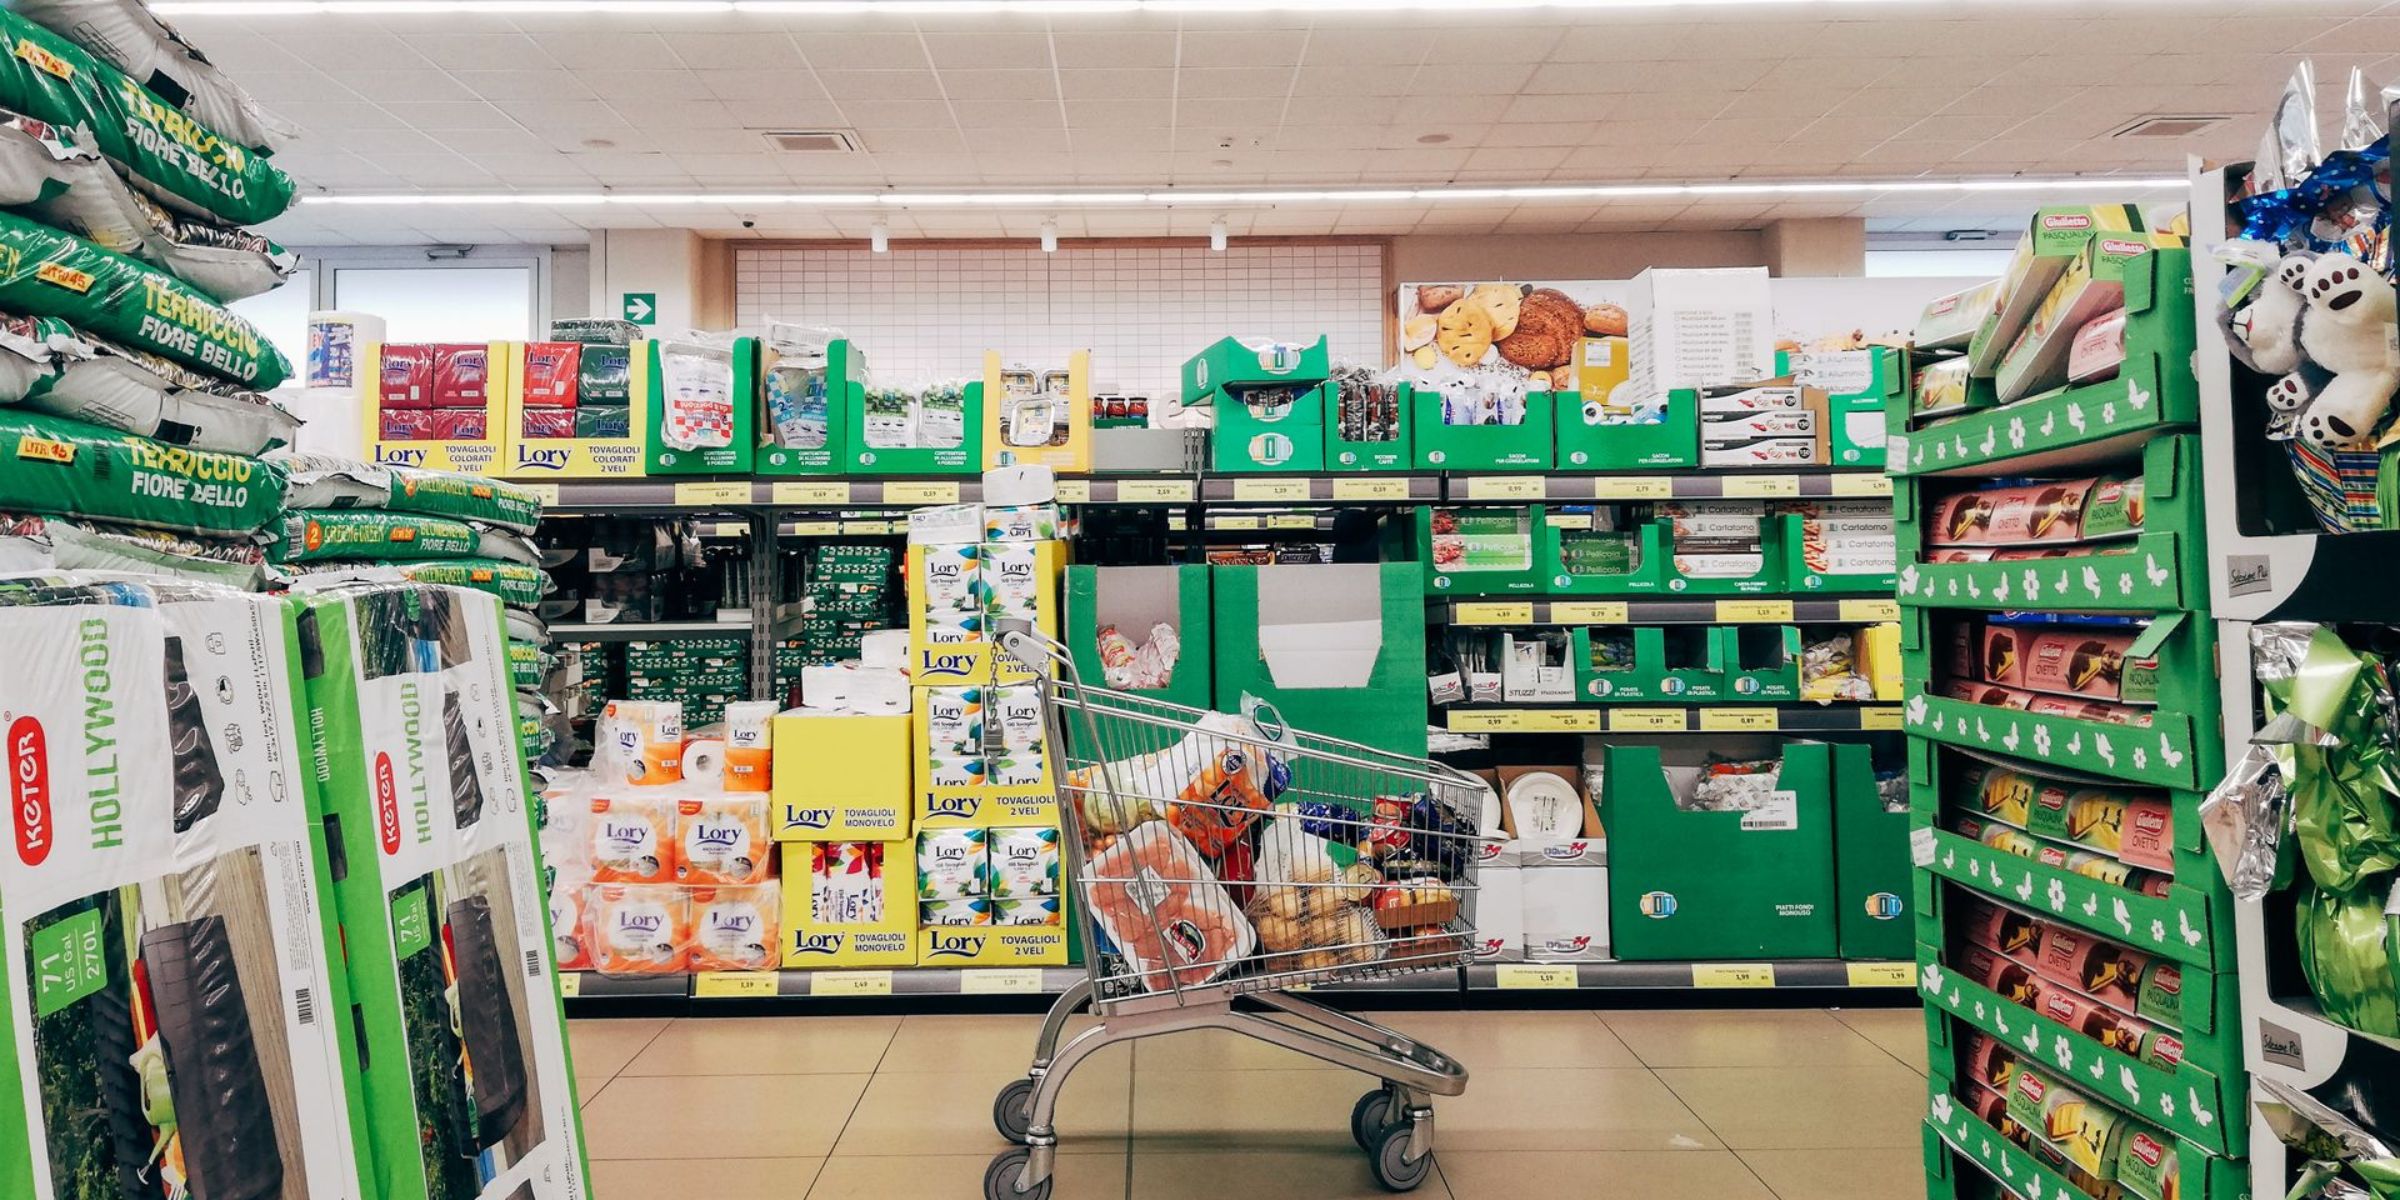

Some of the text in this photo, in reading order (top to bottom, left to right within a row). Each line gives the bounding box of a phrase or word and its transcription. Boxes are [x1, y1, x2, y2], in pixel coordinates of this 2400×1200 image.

[125, 116, 246, 200] FIORE BELLO
[2042, 231, 2094, 241] PASQUALIN
[67, 273, 87, 290] 45
[139, 316, 198, 356] FIORE
[200, 340, 258, 382] BELLO
[50, 443, 68, 460] 45
[375, 444, 428, 469] Lory
[445, 445, 497, 454] TOVAGLIOLI
[518, 444, 572, 469] Lory
[588, 445, 641, 454] TOVAGLIOLI
[123, 436, 252, 484] TERRICCIO
[450, 455, 492, 464] COLORATI
[593, 455, 636, 463] COLORATI
[457, 464, 483, 472] 2 VELI
[600, 464, 627, 472] 2 VELI
[131, 471, 249, 509] FIORE BELLO
[420, 538, 471, 552] FIORE BELLO
[930, 562, 960, 575] Lory
[1001, 562, 1032, 575] Lory
[923, 650, 978, 674] Lory
[933, 705, 963, 718] Lory
[1008, 706, 1037, 718] Lory
[80, 617, 123, 849] HOLLYWOOD
[734, 730, 758, 740] Lory
[311, 707, 330, 783] HOLLYWOOD
[400, 683, 433, 845] HOLLYWOOD
[19, 731, 44, 850] KETER
[379, 762, 397, 845] KETER
[927, 793, 982, 815] Lory
[996, 796, 1056, 805] TOVAGLIOLI
[786, 805, 835, 826] Lory
[845, 809, 896, 817] TOVAGLIOLI
[1010, 808, 1040, 816] 2 VELI
[845, 819, 895, 827] MONOVELO
[607, 823, 649, 841] Lory
[698, 824, 742, 843] Lory
[936, 846, 967, 859] Lory
[1009, 845, 1039, 858] Lory
[2131, 836, 2160, 852] OVETTO
[621, 911, 663, 929] Lory
[712, 911, 755, 928] Lory
[399, 915, 414, 943] 71
[796, 930, 845, 953] Lory
[854, 933, 906, 943] TOVAGLIOLI
[931, 931, 986, 955] Lory
[1000, 935, 1061, 945] TOVAGLIOLI
[83, 920, 101, 980] 270L
[855, 943, 906, 952] MONOVELO
[1015, 946, 1045, 955] 2 VELI
[61, 935, 76, 993] US Gal
[2048, 953, 2073, 971] OVETTO
[41, 952, 62, 995] 71
